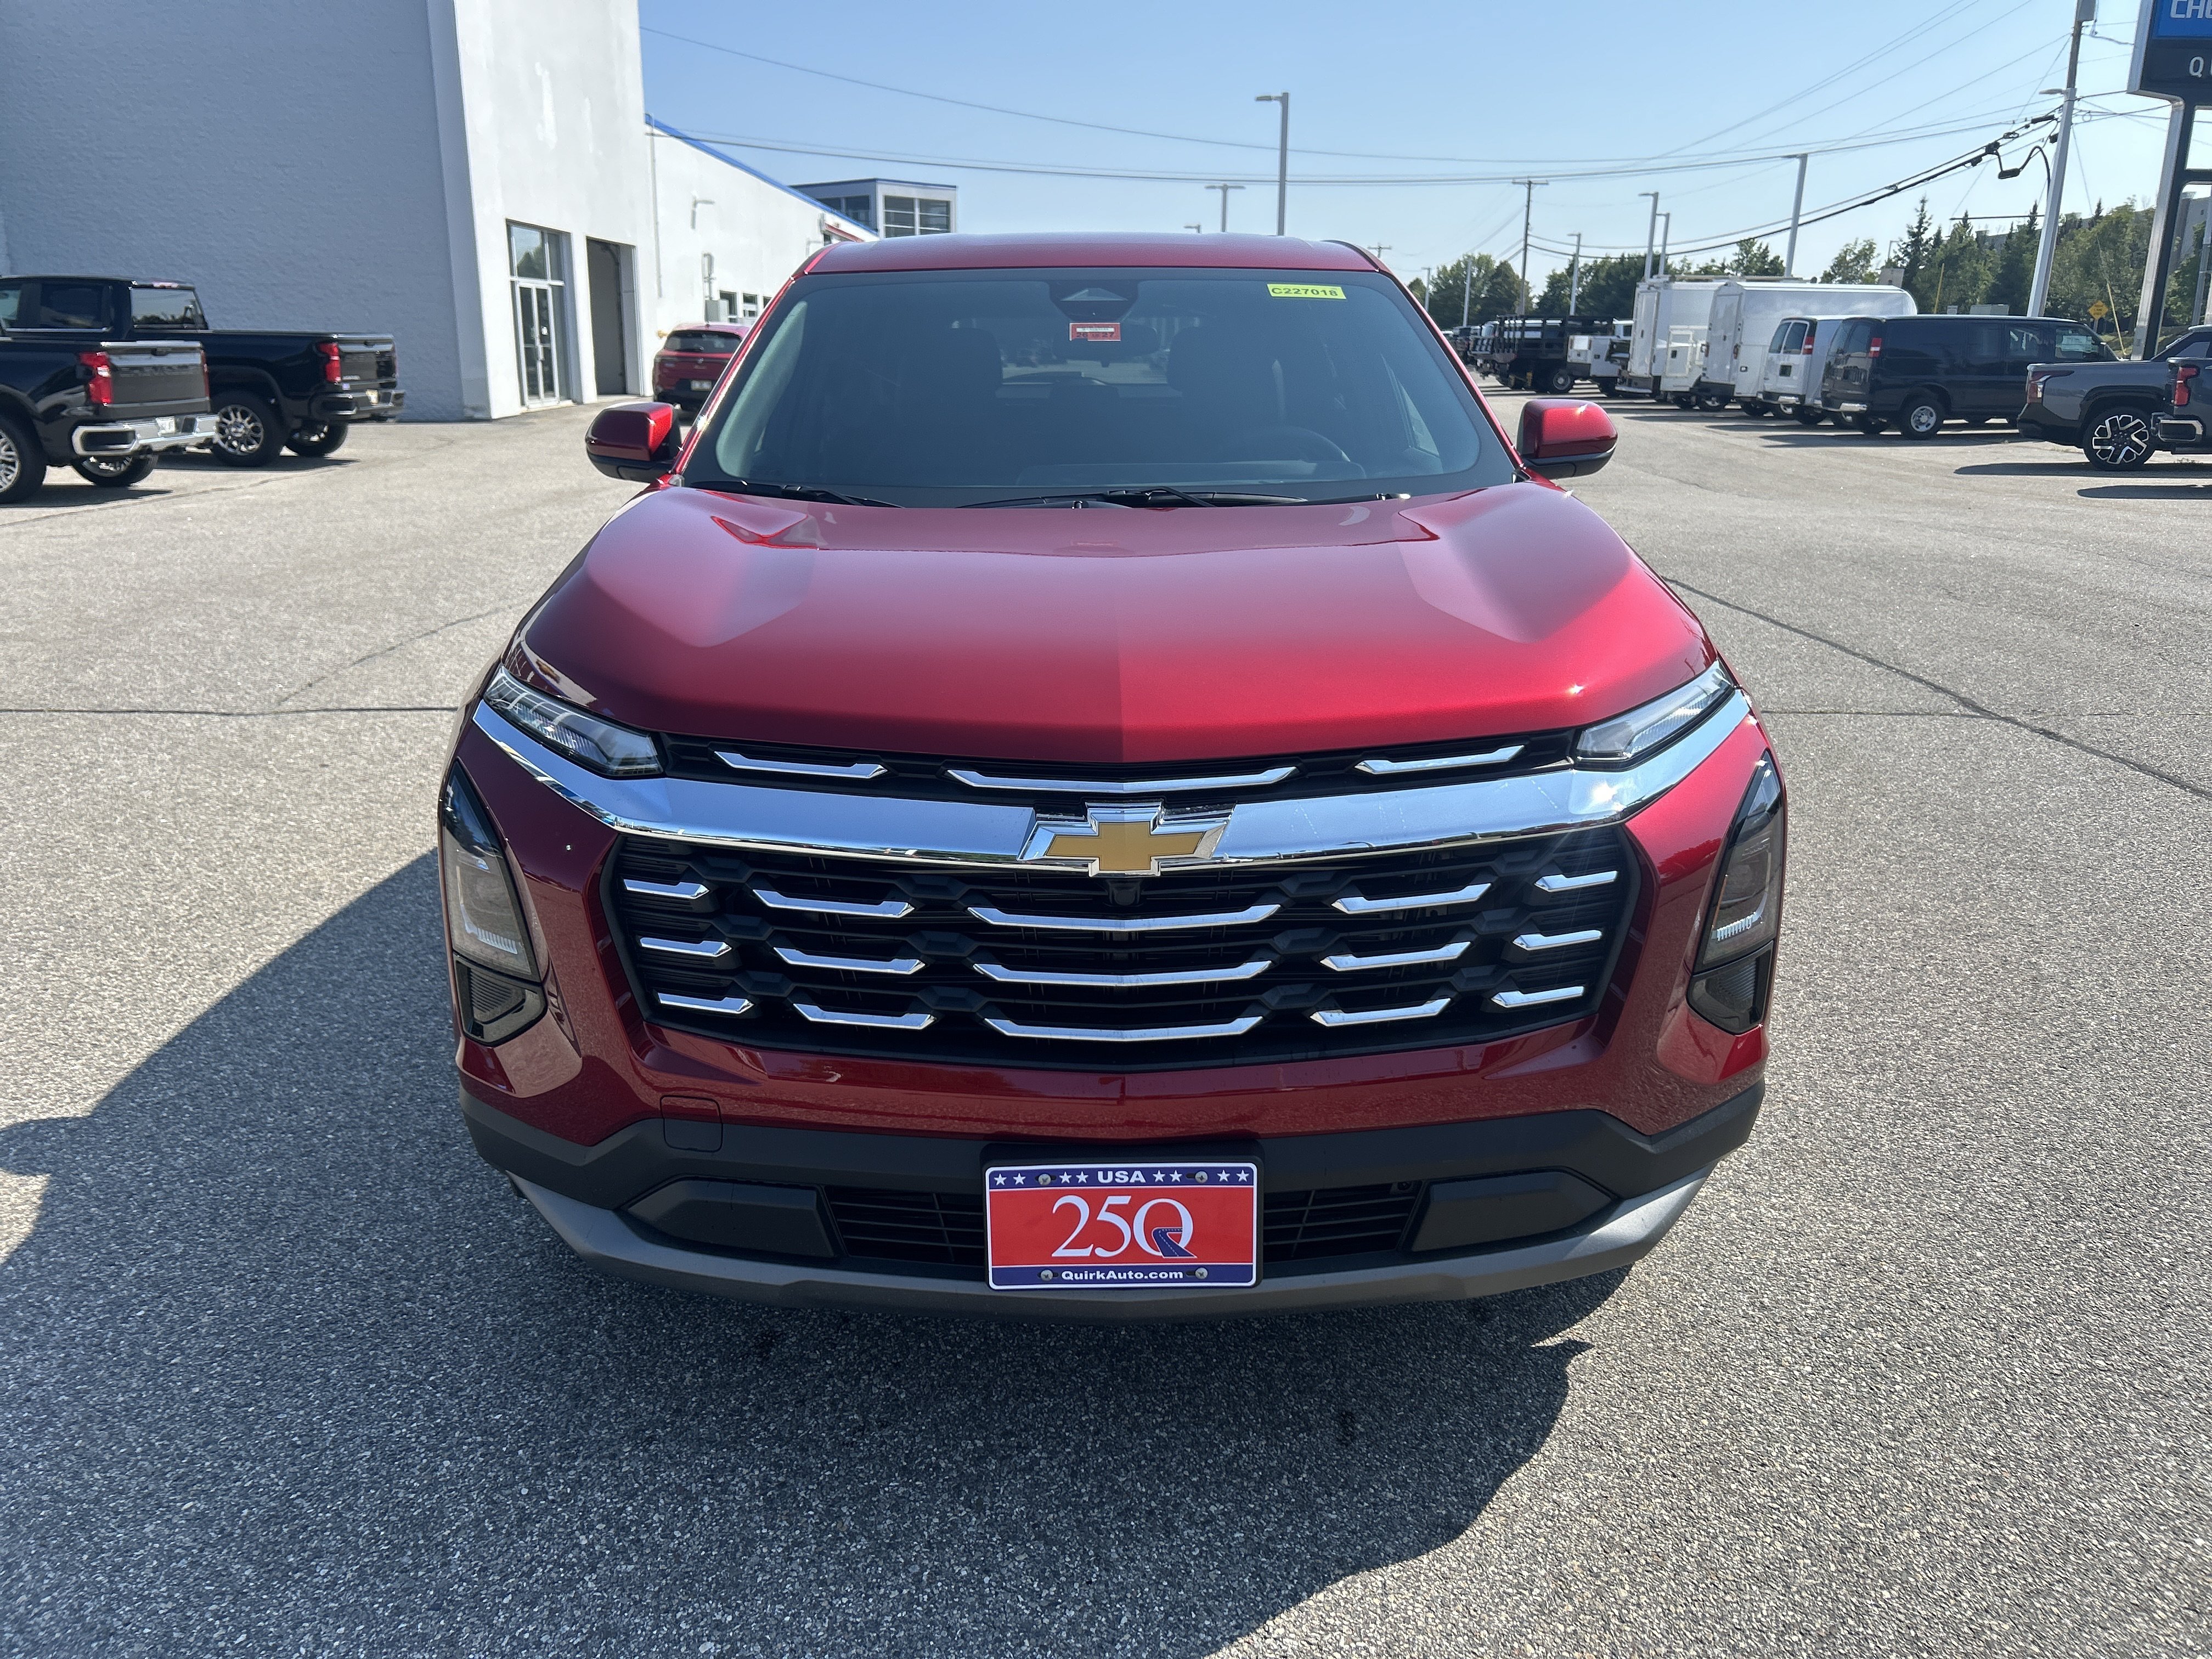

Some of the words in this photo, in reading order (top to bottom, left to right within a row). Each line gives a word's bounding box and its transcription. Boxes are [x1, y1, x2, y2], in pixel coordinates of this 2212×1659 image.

[2189, 57, 2212, 77] Q
[1272, 287, 1338, 296] C227018
[1098, 1170, 1146, 1183] USA
[1061, 1270, 1183, 1280] QuirkAuto.com
